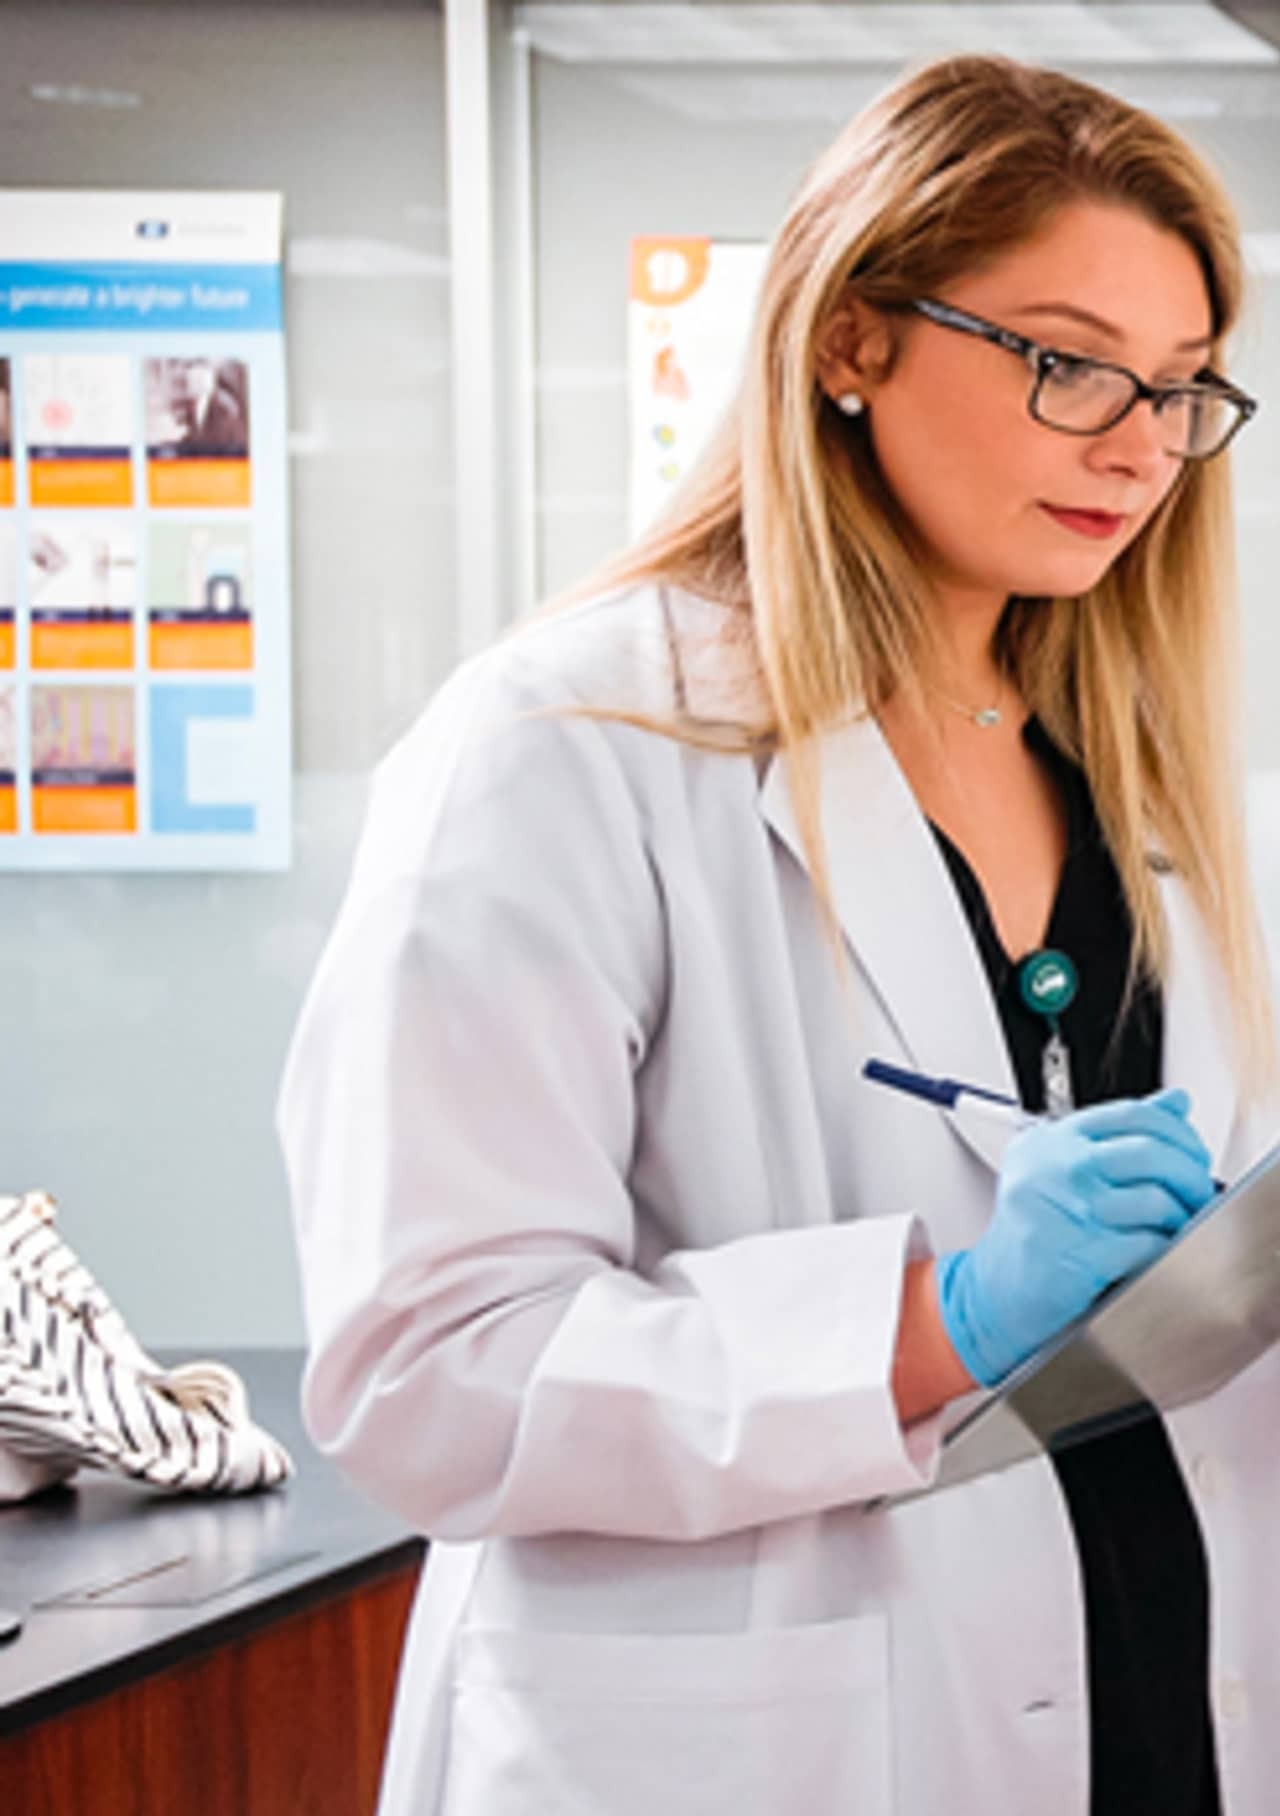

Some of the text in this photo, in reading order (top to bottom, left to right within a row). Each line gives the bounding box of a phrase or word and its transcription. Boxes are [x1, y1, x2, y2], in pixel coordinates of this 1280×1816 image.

[10, 286, 88, 313] generate
[113, 283, 185, 314] brighter
[191, 282, 249, 309] future
